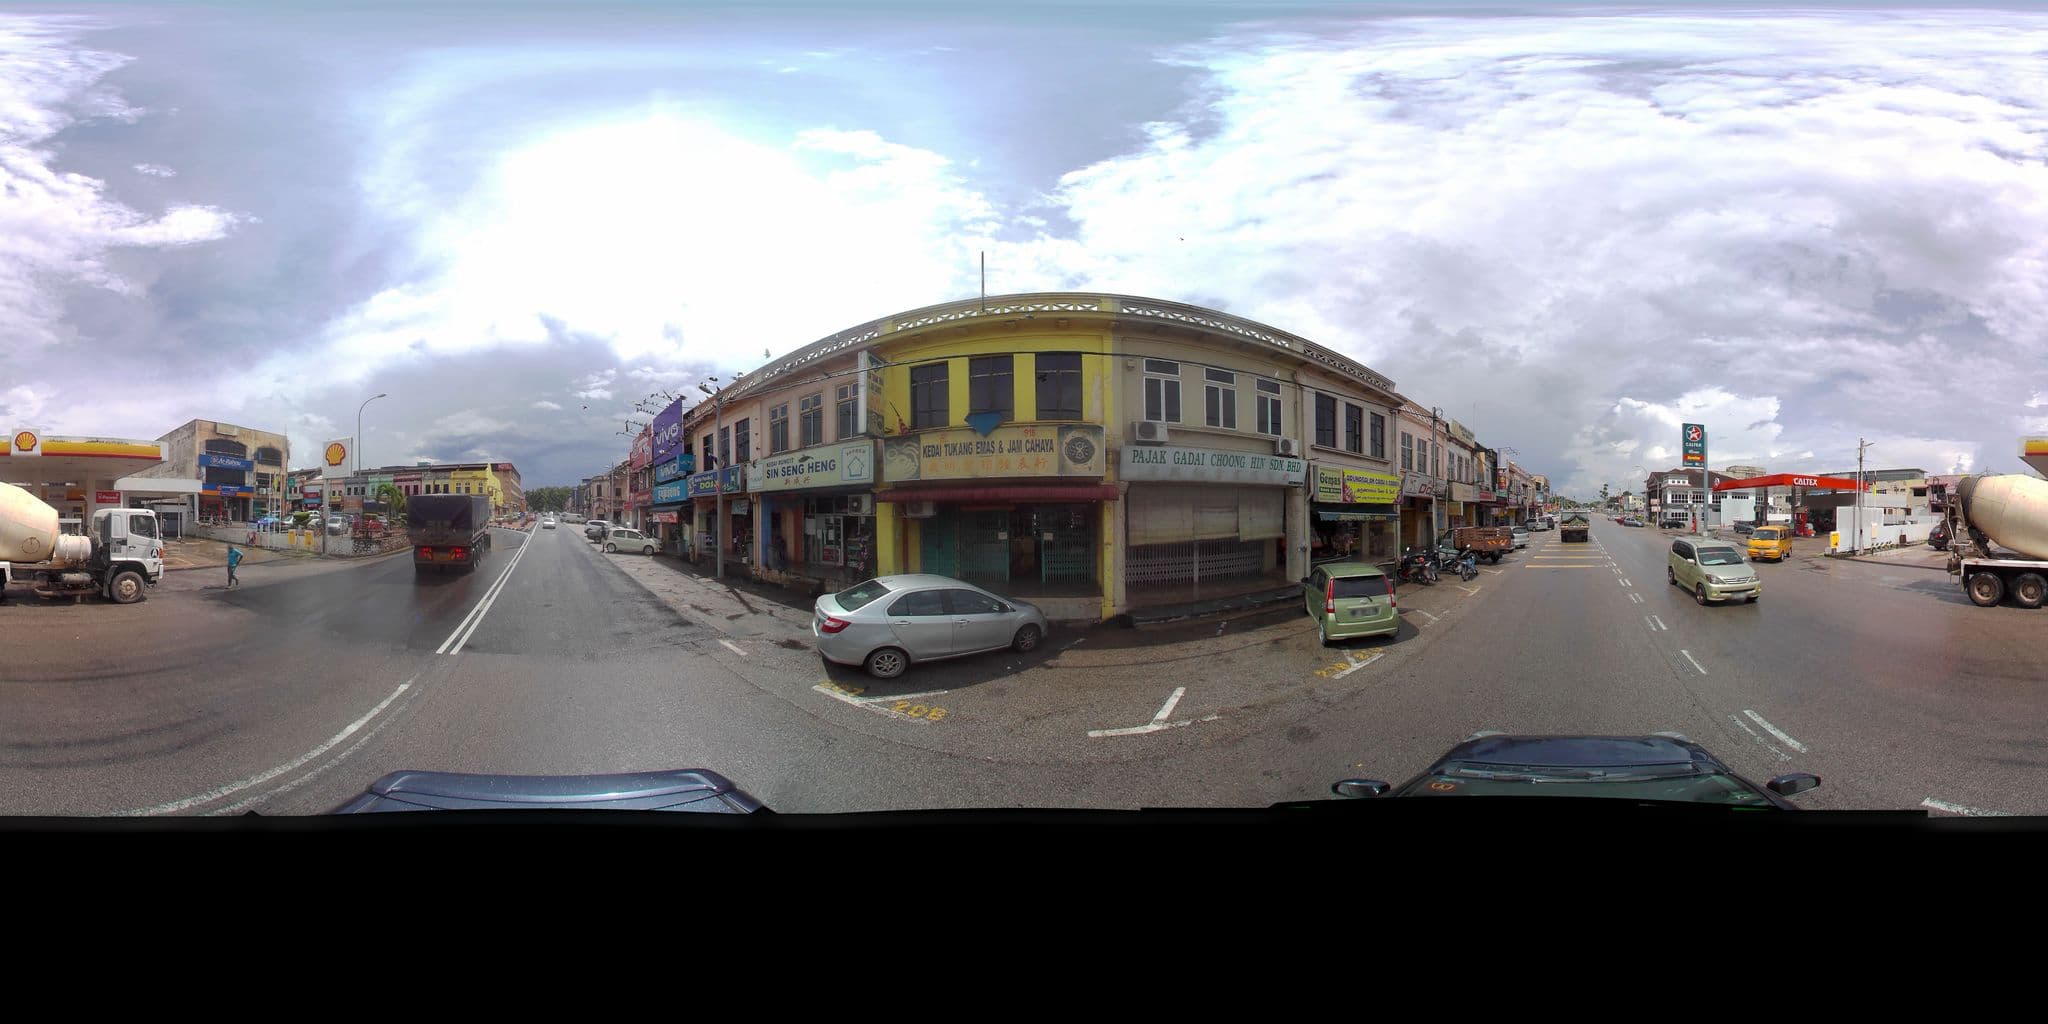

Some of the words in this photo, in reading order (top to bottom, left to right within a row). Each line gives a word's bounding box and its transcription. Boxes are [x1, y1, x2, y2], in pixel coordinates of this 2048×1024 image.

[656, 423, 679, 446] vivo
[922, 444, 942, 458] KEDAI
[944, 441, 973, 456] TUKANG
[976, 440, 995, 455] EMAS
[998, 442, 1004, 453] &
[1007, 440, 1023, 454] JAM
[1025, 438, 1054, 453] CAHAYA
[766, 469, 779, 479] SIN
[781, 463, 805, 477] SENG
[807, 459, 836, 474] HENG
[1132, 449, 1167, 464] PAJAK
[1173, 451, 1206, 466] GADAI
[1210, 455, 1246, 469] CHOONG
[1250, 456, 1265, 470] HIN
[1793, 478, 1818, 487] CALTEX
